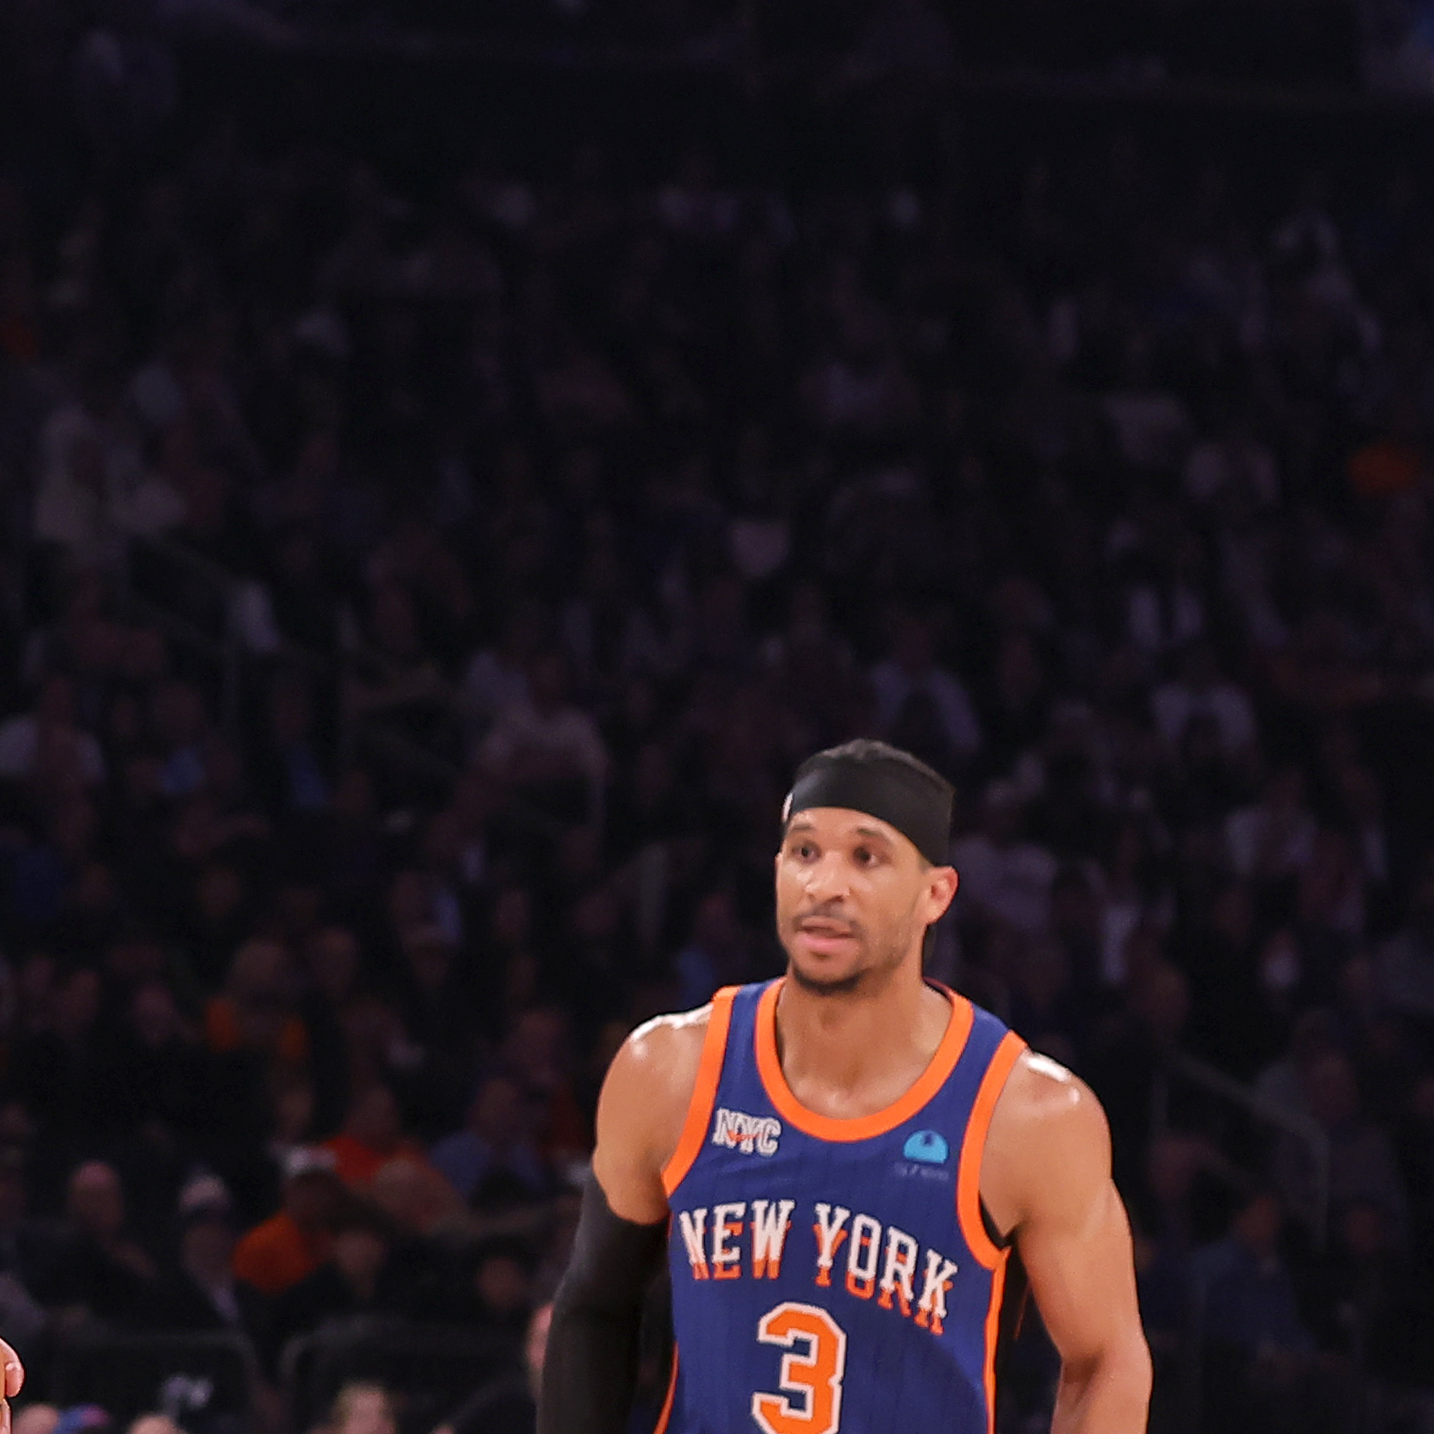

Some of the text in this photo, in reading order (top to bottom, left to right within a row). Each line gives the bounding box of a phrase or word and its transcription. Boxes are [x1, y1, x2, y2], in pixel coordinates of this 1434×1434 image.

[712, 1108, 782, 1156] NYC
[679, 1199, 958, 1335] NEW YORK
